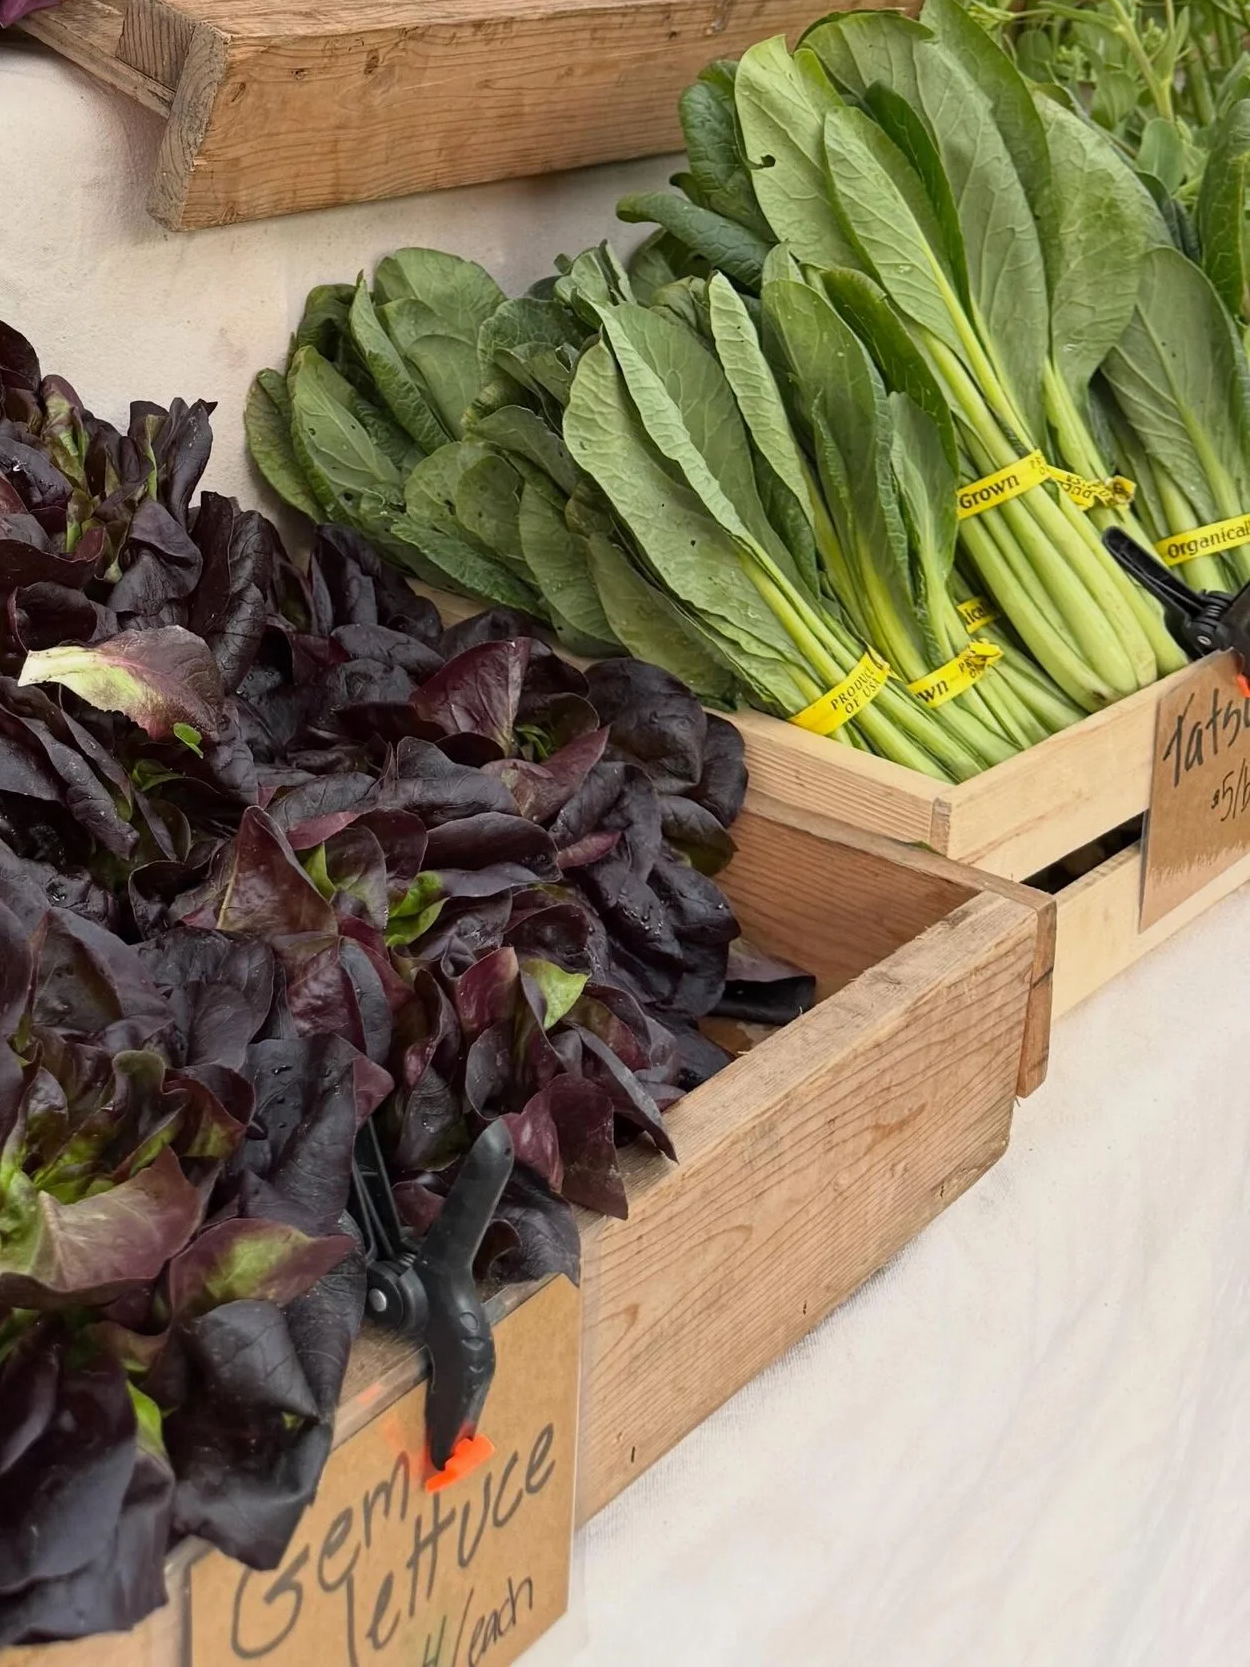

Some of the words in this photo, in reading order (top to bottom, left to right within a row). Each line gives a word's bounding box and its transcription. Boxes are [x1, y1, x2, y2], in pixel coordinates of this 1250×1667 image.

[959, 473, 1020, 511] Grown
[830, 665, 875, 711] PRODUC
[231, 1448, 412, 1660] Gem
